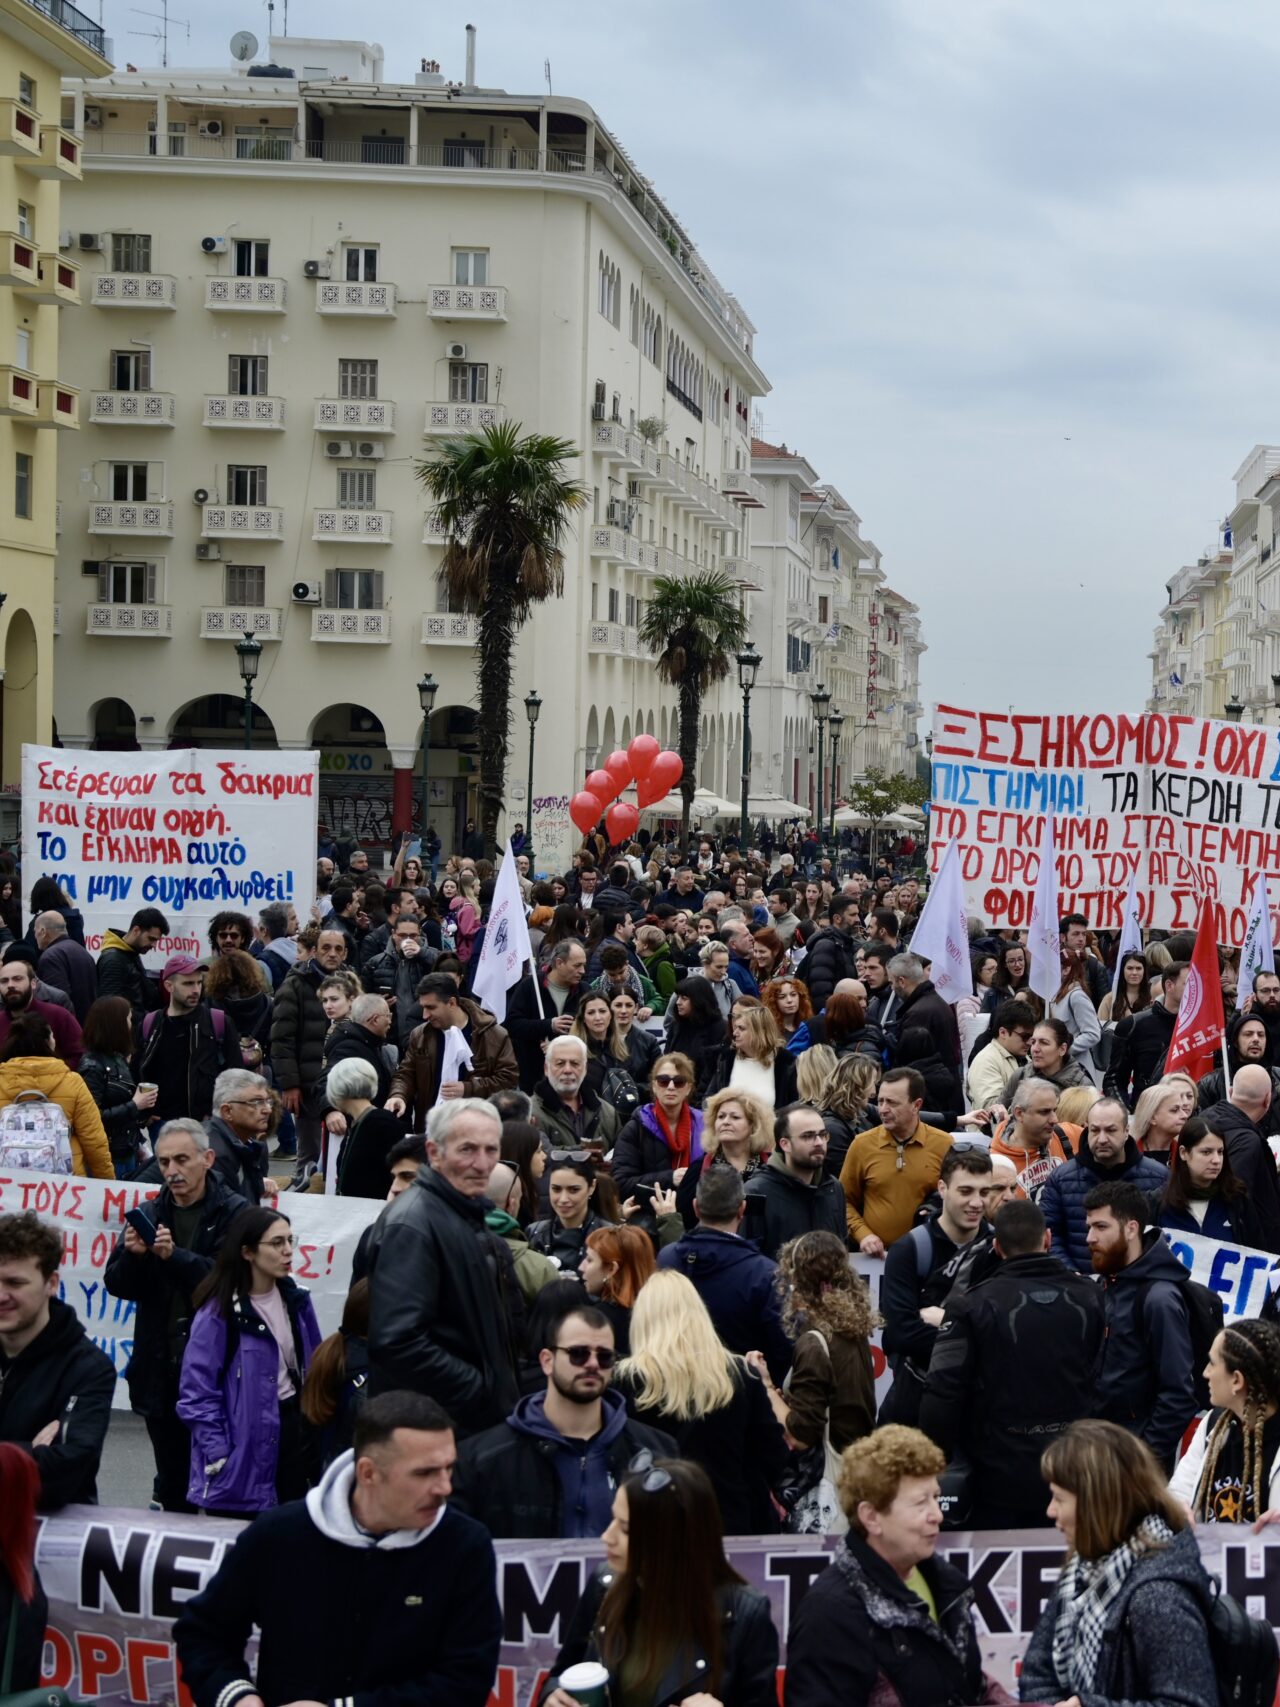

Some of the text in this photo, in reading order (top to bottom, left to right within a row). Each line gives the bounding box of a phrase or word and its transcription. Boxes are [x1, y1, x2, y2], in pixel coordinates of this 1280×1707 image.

[37, 761, 158, 800] Στέρεψαν
[169, 771, 206, 795] τα
[931, 762, 1084, 816] ΠΙΣΤΗΜΙΑ!
[1102, 771, 1139, 812] ΤΑ
[1151, 770, 1243, 823] ΚΕΡΔΗ
[163, 803, 232, 838] οργή.
[930, 805, 967, 838] ΤΟ
[1123, 814, 1175, 851] ΣΤΑ
[81, 832, 183, 865] ΕΓΚΛΗΜΑ
[187, 837, 247, 866] αυτό
[1092, 850, 1141, 888] ΤΟΥ
[87, 873, 133, 904] μην
[142, 868, 295, 912] συγκαλυφθεί!
[16, 1182, 86, 1221] ΤΟΥΣ
